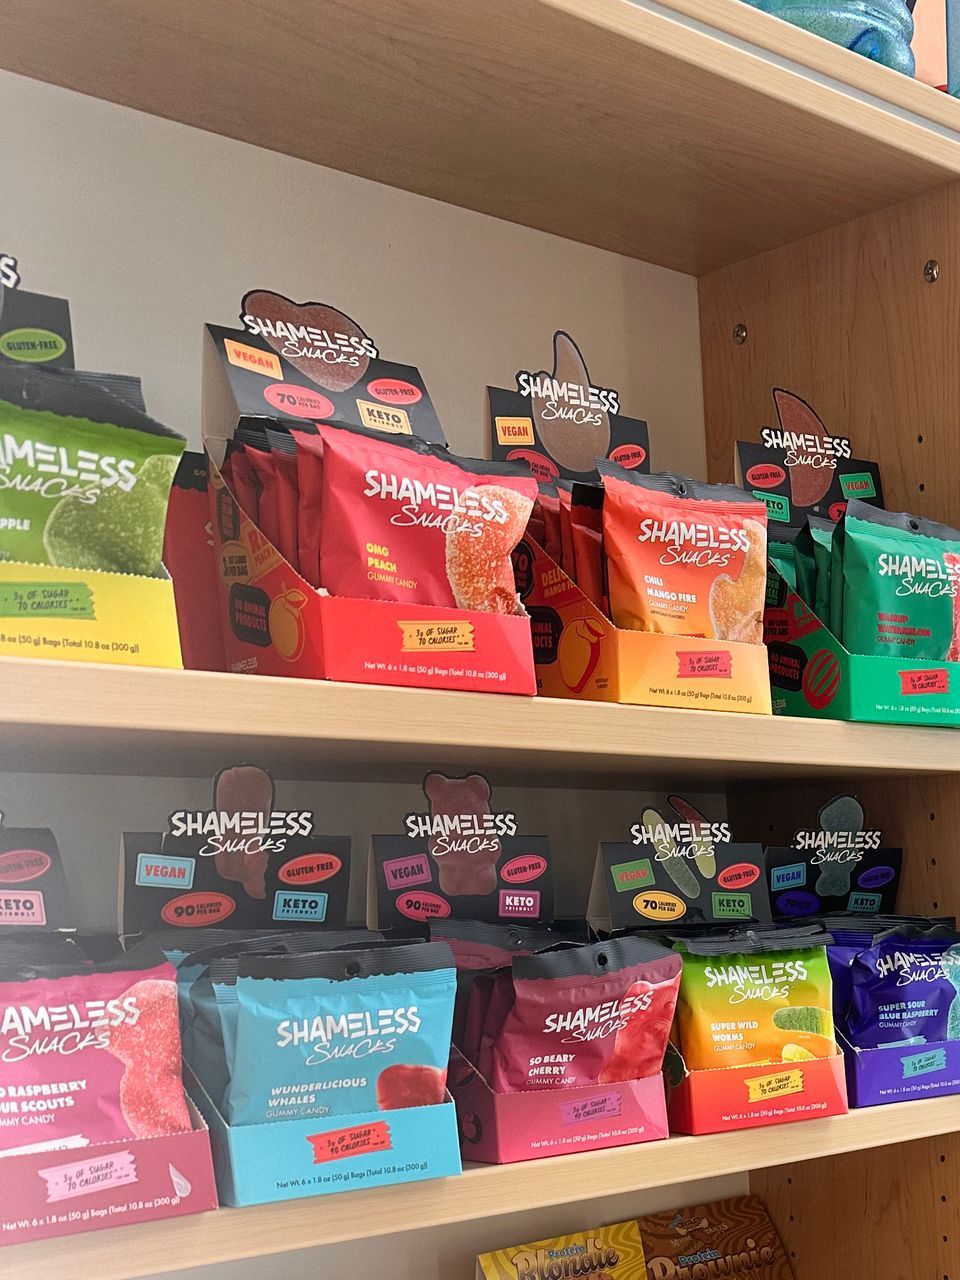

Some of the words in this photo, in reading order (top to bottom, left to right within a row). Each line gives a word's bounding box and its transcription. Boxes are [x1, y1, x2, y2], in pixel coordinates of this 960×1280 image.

[244, 315, 377, 358] SHAMELESS
[234, 349, 273, 369] VEGAN
[277, 393, 296, 405] 70
[518, 373, 619, 414] SHAMELESS
[367, 408, 401, 423] KETO
[501, 425, 529, 437] VEGAN
[762, 429, 851, 458] SHAMELESS
[363, 470, 510, 525] SHAMELESS
[637, 518, 750, 553] SHAMELESS
[366, 543, 390, 557] OMG
[368, 557, 397, 573] PEACH
[644, 575, 664, 587] CHILI
[647, 587, 676, 601] MANGO
[678, 594, 696, 603] FIRE
[171, 811, 313, 837] SHAMELESS
[405, 814, 517, 838] SHAMELESS
[630, 822, 731, 845] SHAMELESS
[795, 831, 881, 850] SHAMELESS
[144, 865, 186, 879] VEGAN
[286, 861, 334, 878] GLUTEN-FREE
[391, 863, 424, 880] VEGAN
[506, 861, 542, 877] GLUTEN-FREE
[282, 898, 319, 910] KETO
[405, 899, 421, 911] 90
[505, 896, 534, 907] KETO
[643, 899, 658, 911] 70
[718, 898, 746, 909] KETO
[853, 897, 876, 907] KETO
[174, 904, 195, 917] 90
[704, 961, 808, 988] SHAMELESS
[542, 991, 654, 1034] SHAMELESS
[276, 1006, 422, 1048] SHAMELESS
[710, 1022, 735, 1032] SUPER
[737, 1020, 759, 1030] WILD
[712, 1031, 744, 1043] WORMS
[529, 1056, 541, 1067] SO
[543, 1053, 575, 1065] BEARY
[528, 1066, 566, 1077] CHERRY
[9, 1080, 87, 1098] RASPBERRY
[271, 1077, 368, 1096] WUNDERLICIOUS
[268, 1094, 316, 1107] WHALES
[265, 1107, 297, 1118] GUMMY
[300, 1105, 331, 1116] CANDY
